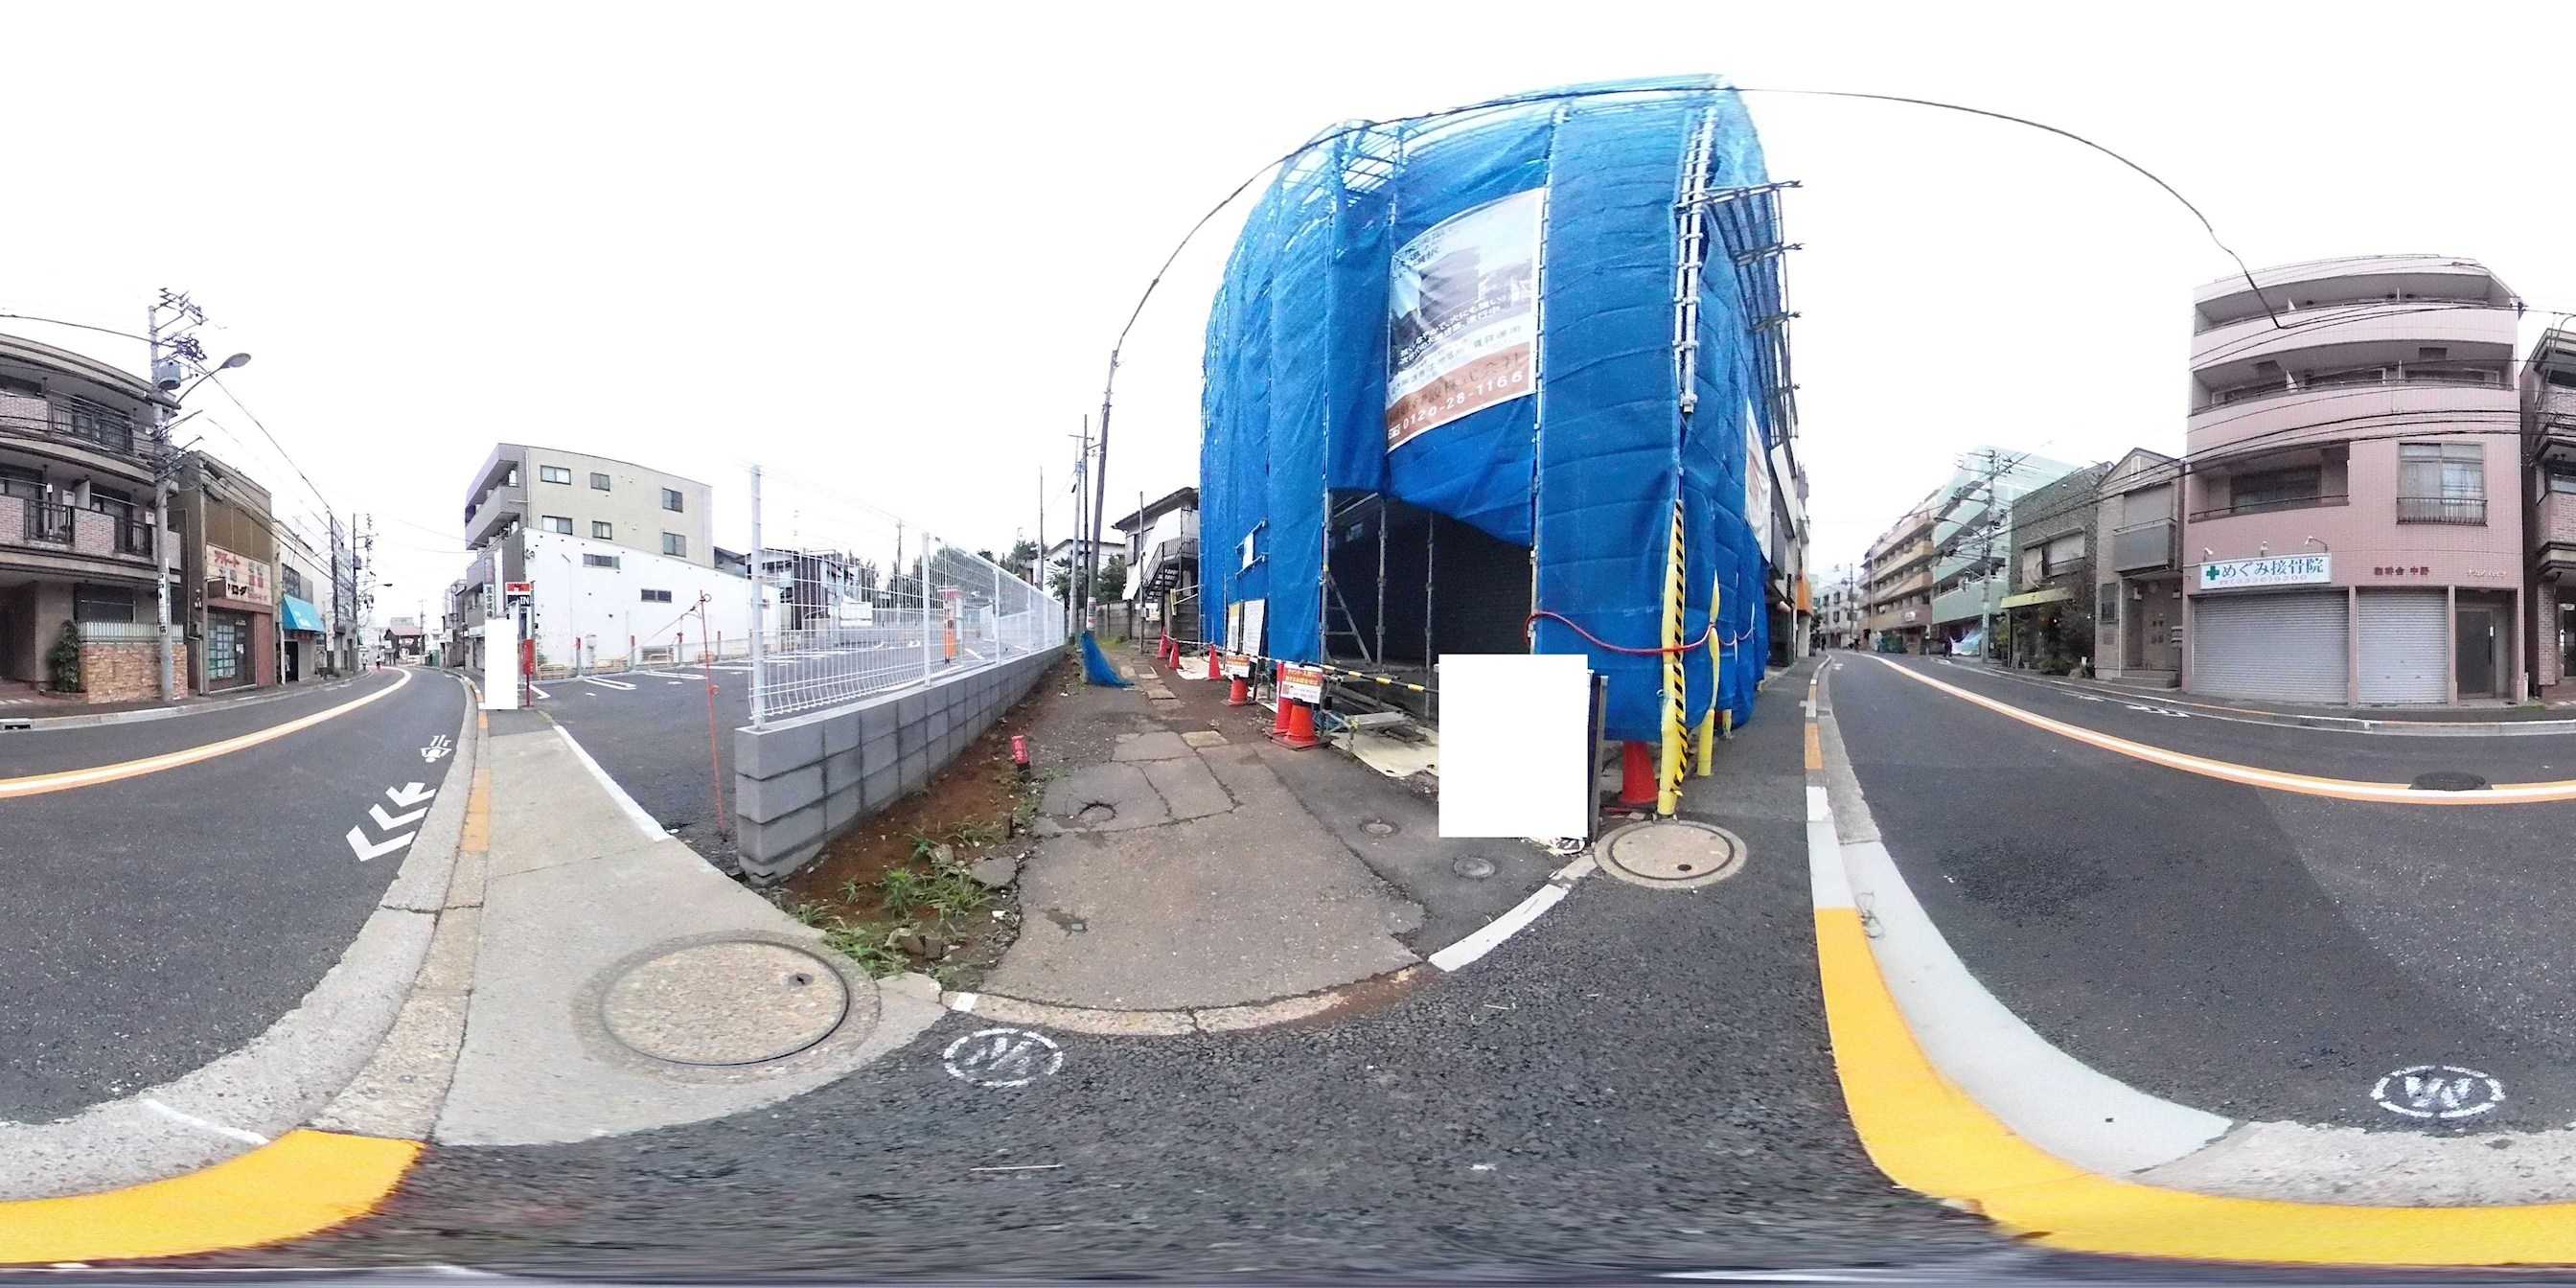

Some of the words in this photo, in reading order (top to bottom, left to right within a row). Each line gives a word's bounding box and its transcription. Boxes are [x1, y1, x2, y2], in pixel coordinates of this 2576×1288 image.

[2222, 557, 2324, 578] めぐみ接骨院
